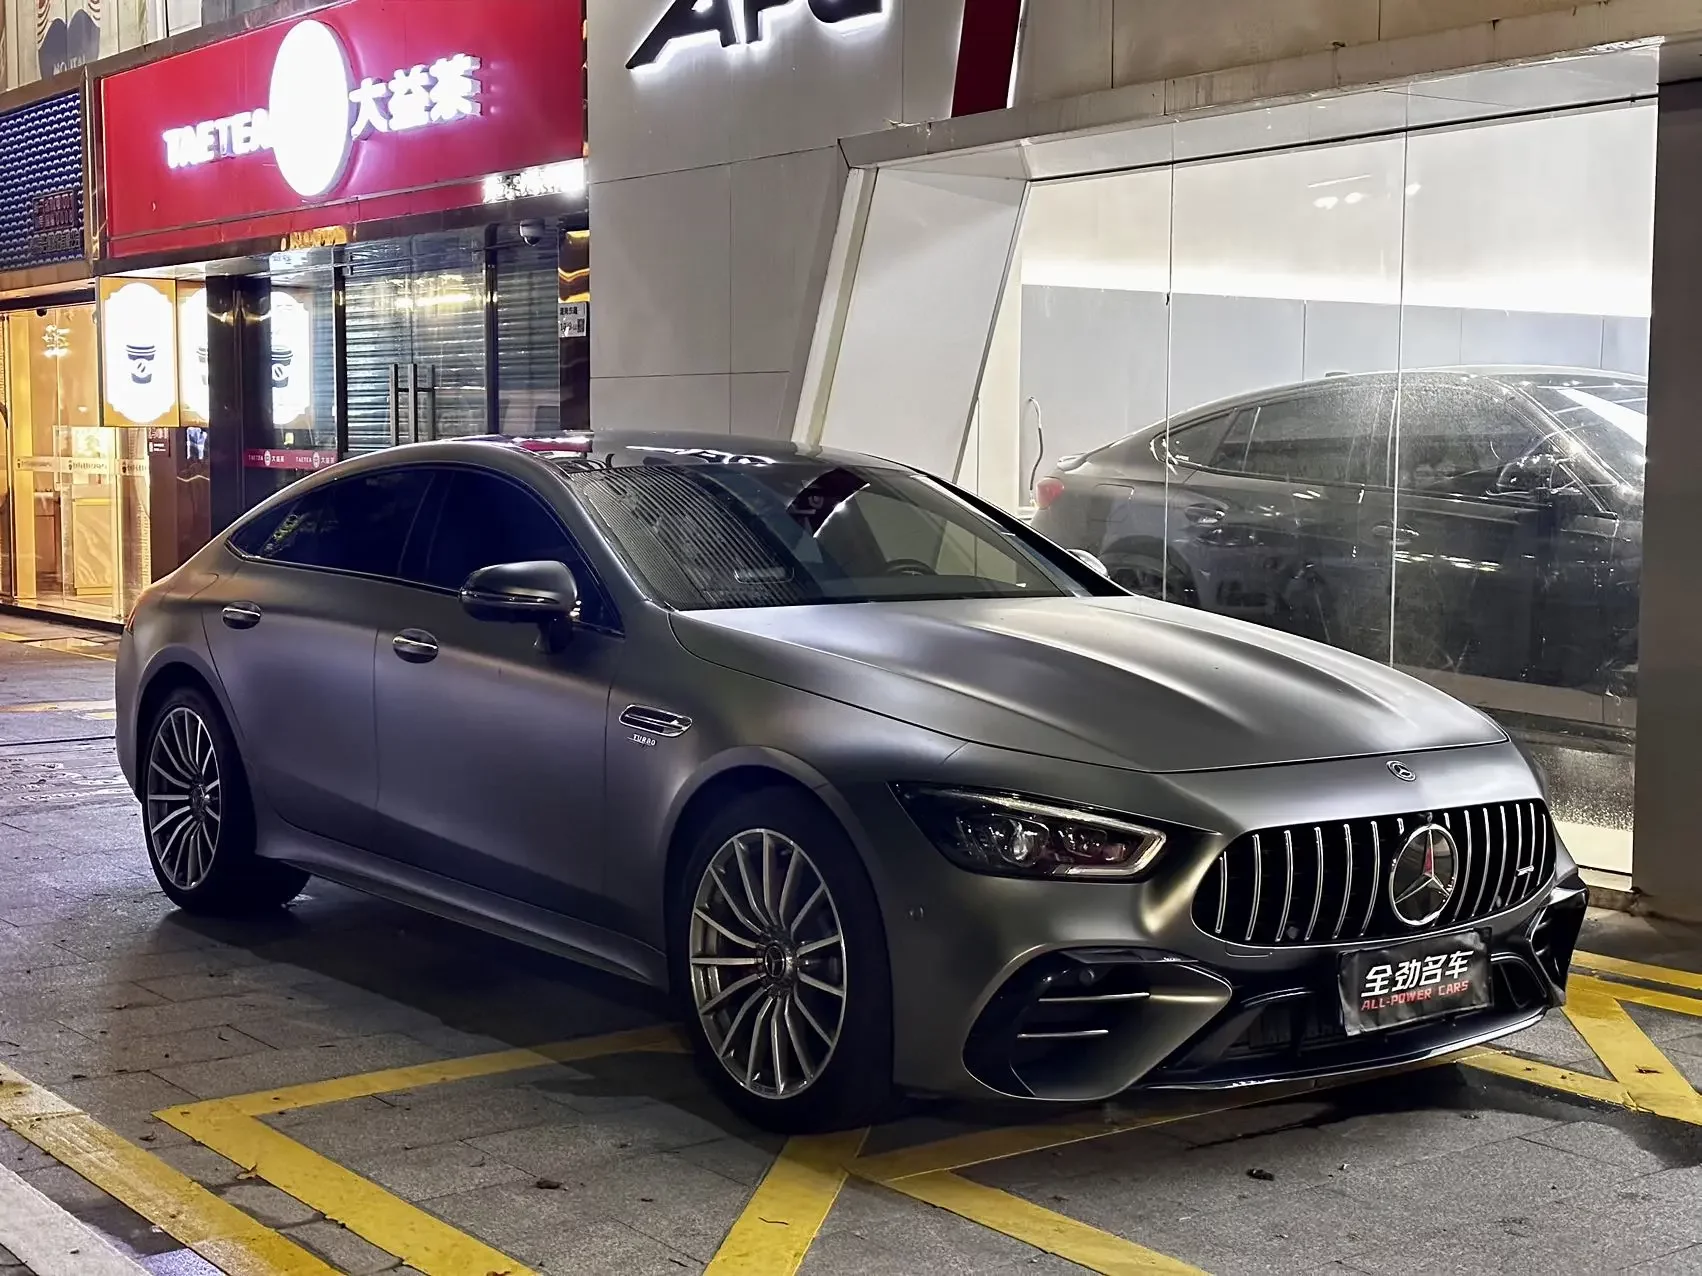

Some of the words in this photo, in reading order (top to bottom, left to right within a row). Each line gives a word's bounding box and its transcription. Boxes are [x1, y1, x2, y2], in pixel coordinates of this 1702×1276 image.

[349, 53, 478, 140] 大益茶
[1360, 950, 1474, 998] 全劲名车
[1360, 988, 1432, 1011] ALL-POWER
[1438, 980, 1469, 996] CARS
